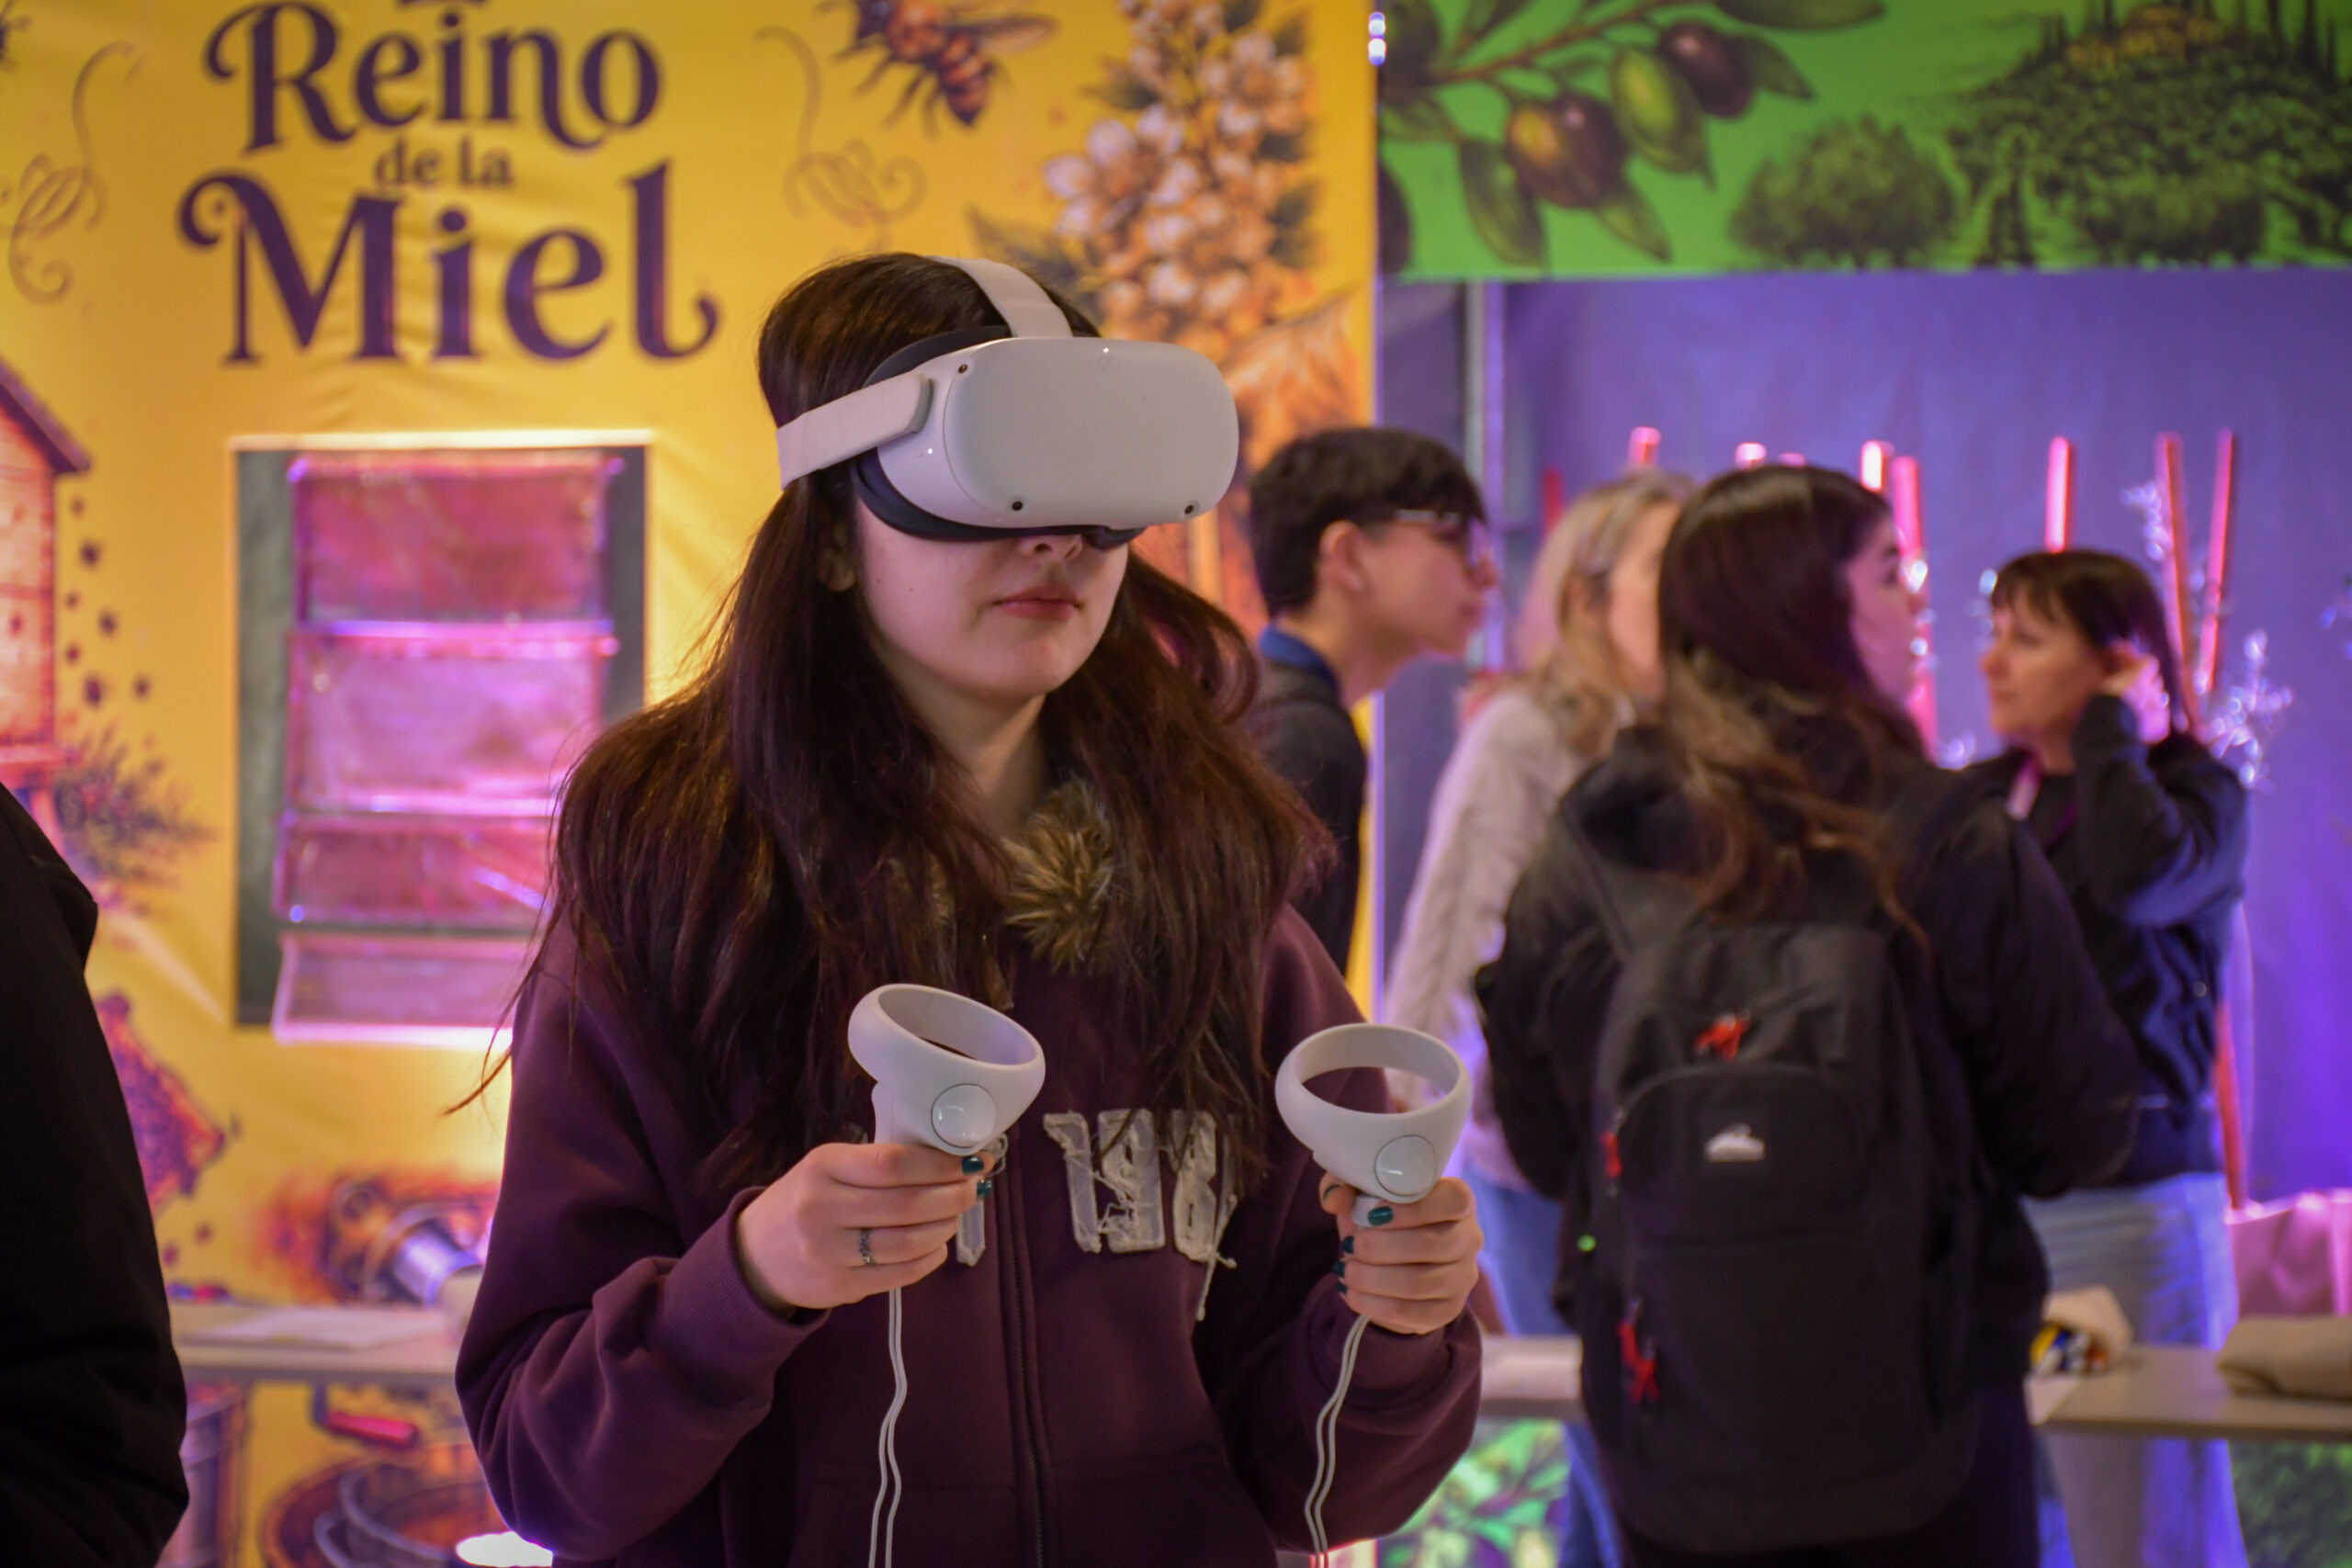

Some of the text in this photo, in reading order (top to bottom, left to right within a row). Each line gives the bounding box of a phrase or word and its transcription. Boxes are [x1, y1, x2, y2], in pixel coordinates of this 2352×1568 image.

[200, 0, 664, 156] Reino
[374, 137, 514, 186] de la
[175, 160, 723, 366] Miel
